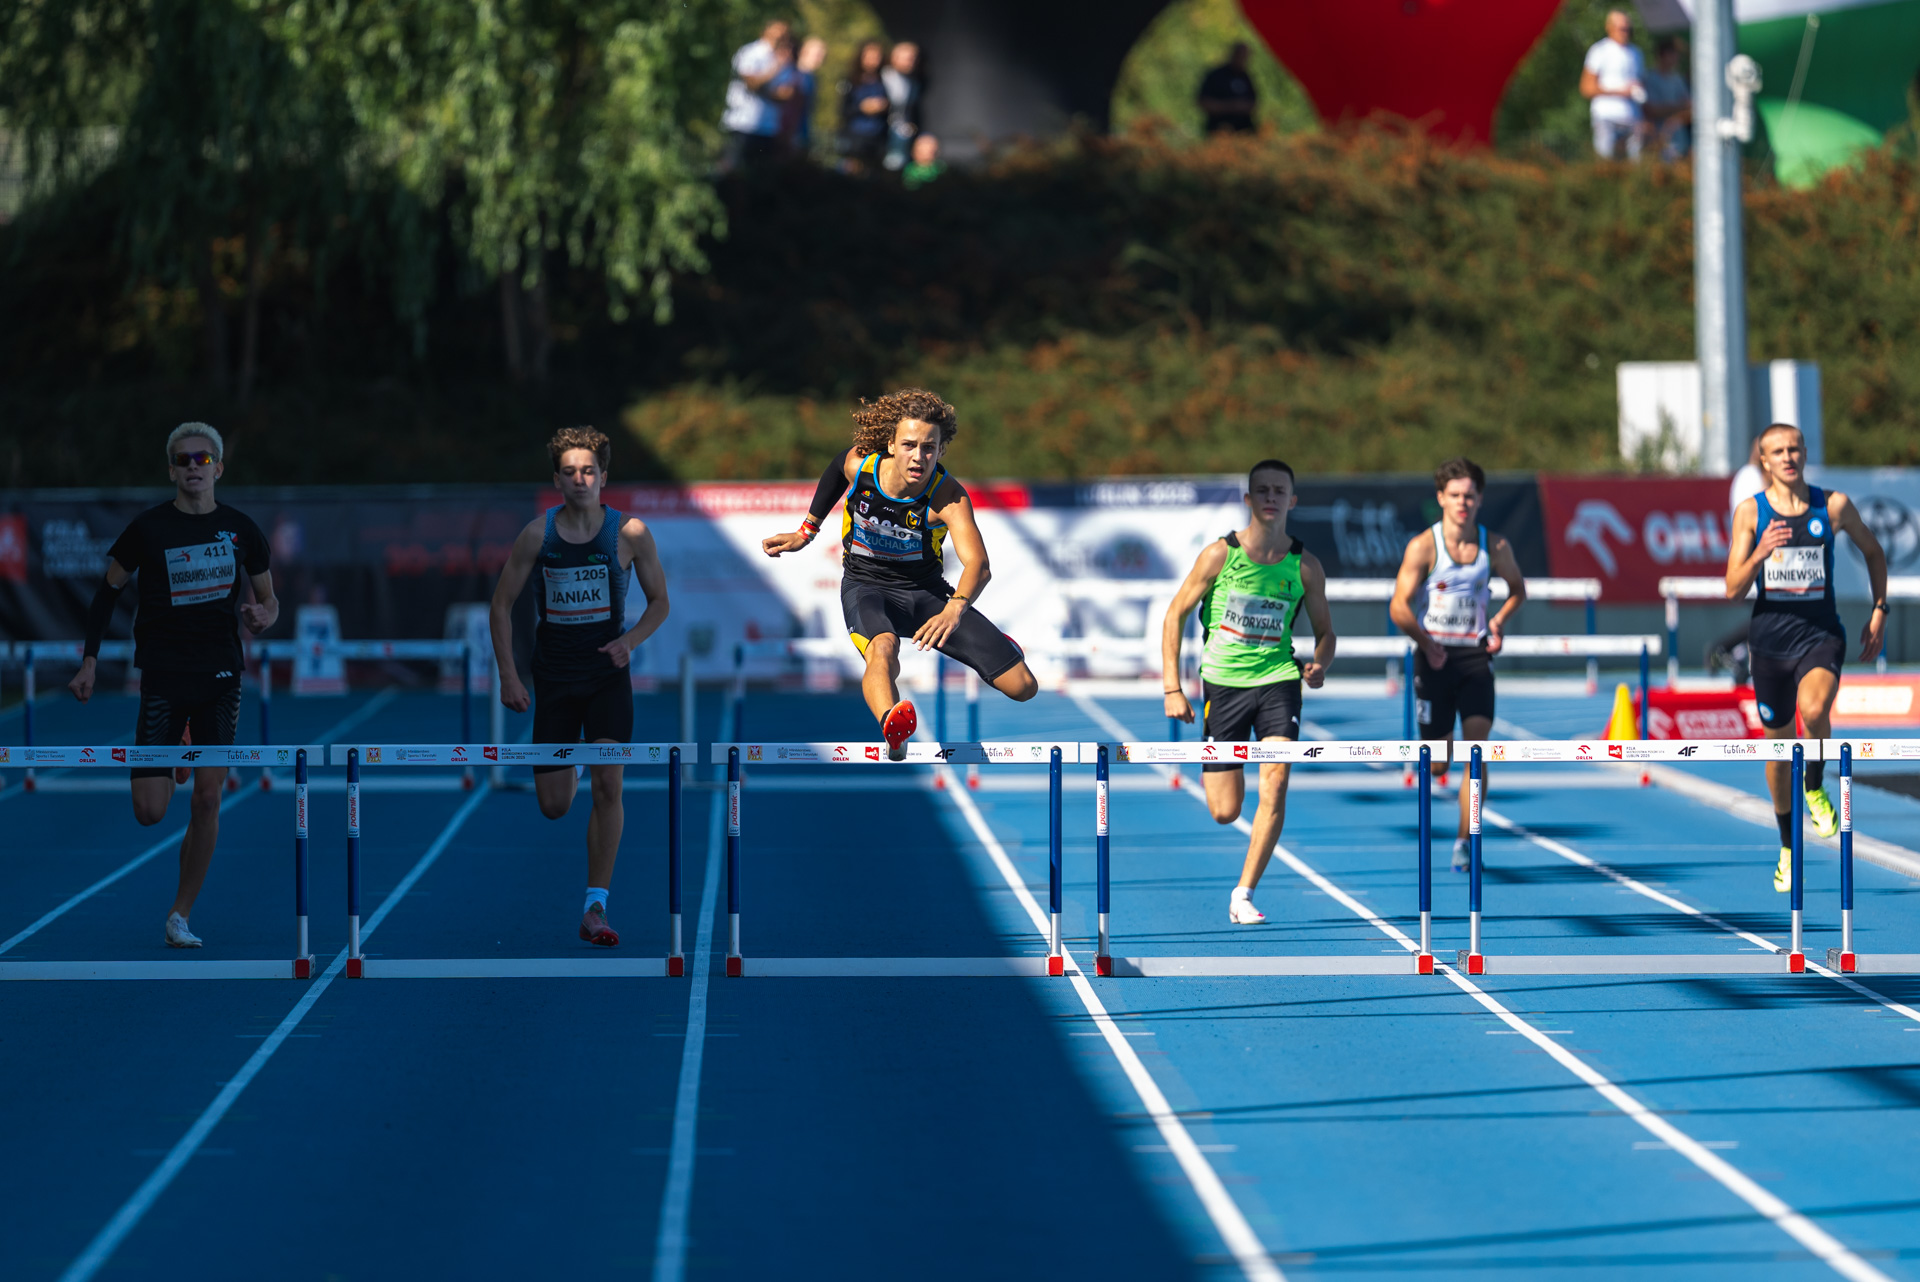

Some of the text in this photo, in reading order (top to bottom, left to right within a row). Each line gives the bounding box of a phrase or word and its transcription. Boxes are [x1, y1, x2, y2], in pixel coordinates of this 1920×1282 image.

[856, 528, 919, 551] BRZUCHALSKI
[204, 544, 227, 558] 411
[1798, 549, 1819, 561] 596
[171, 564, 234, 585] BOGUSŁAWSKI-MICHNIAK
[574, 567, 606, 582] 1205
[1767, 568, 1824, 582] ŁUNIEWSKI
[552, 588, 602, 604] JANIAK
[1224, 610, 1282, 631] FRYDRYSIAK
[553, 748, 574, 759] 4F
[595, 747, 621, 757] lublin
[935, 749, 955, 759] 4F
[977, 747, 1003, 757] lublin
[1303, 747, 1324, 758] 4F
[1345, 746, 1371, 755] lublin
[1677, 746, 1698, 756] 4F
[1719, 744, 1745, 754] lublin
[181, 751, 203, 761] 4F
[223, 750, 249, 760] lublin
